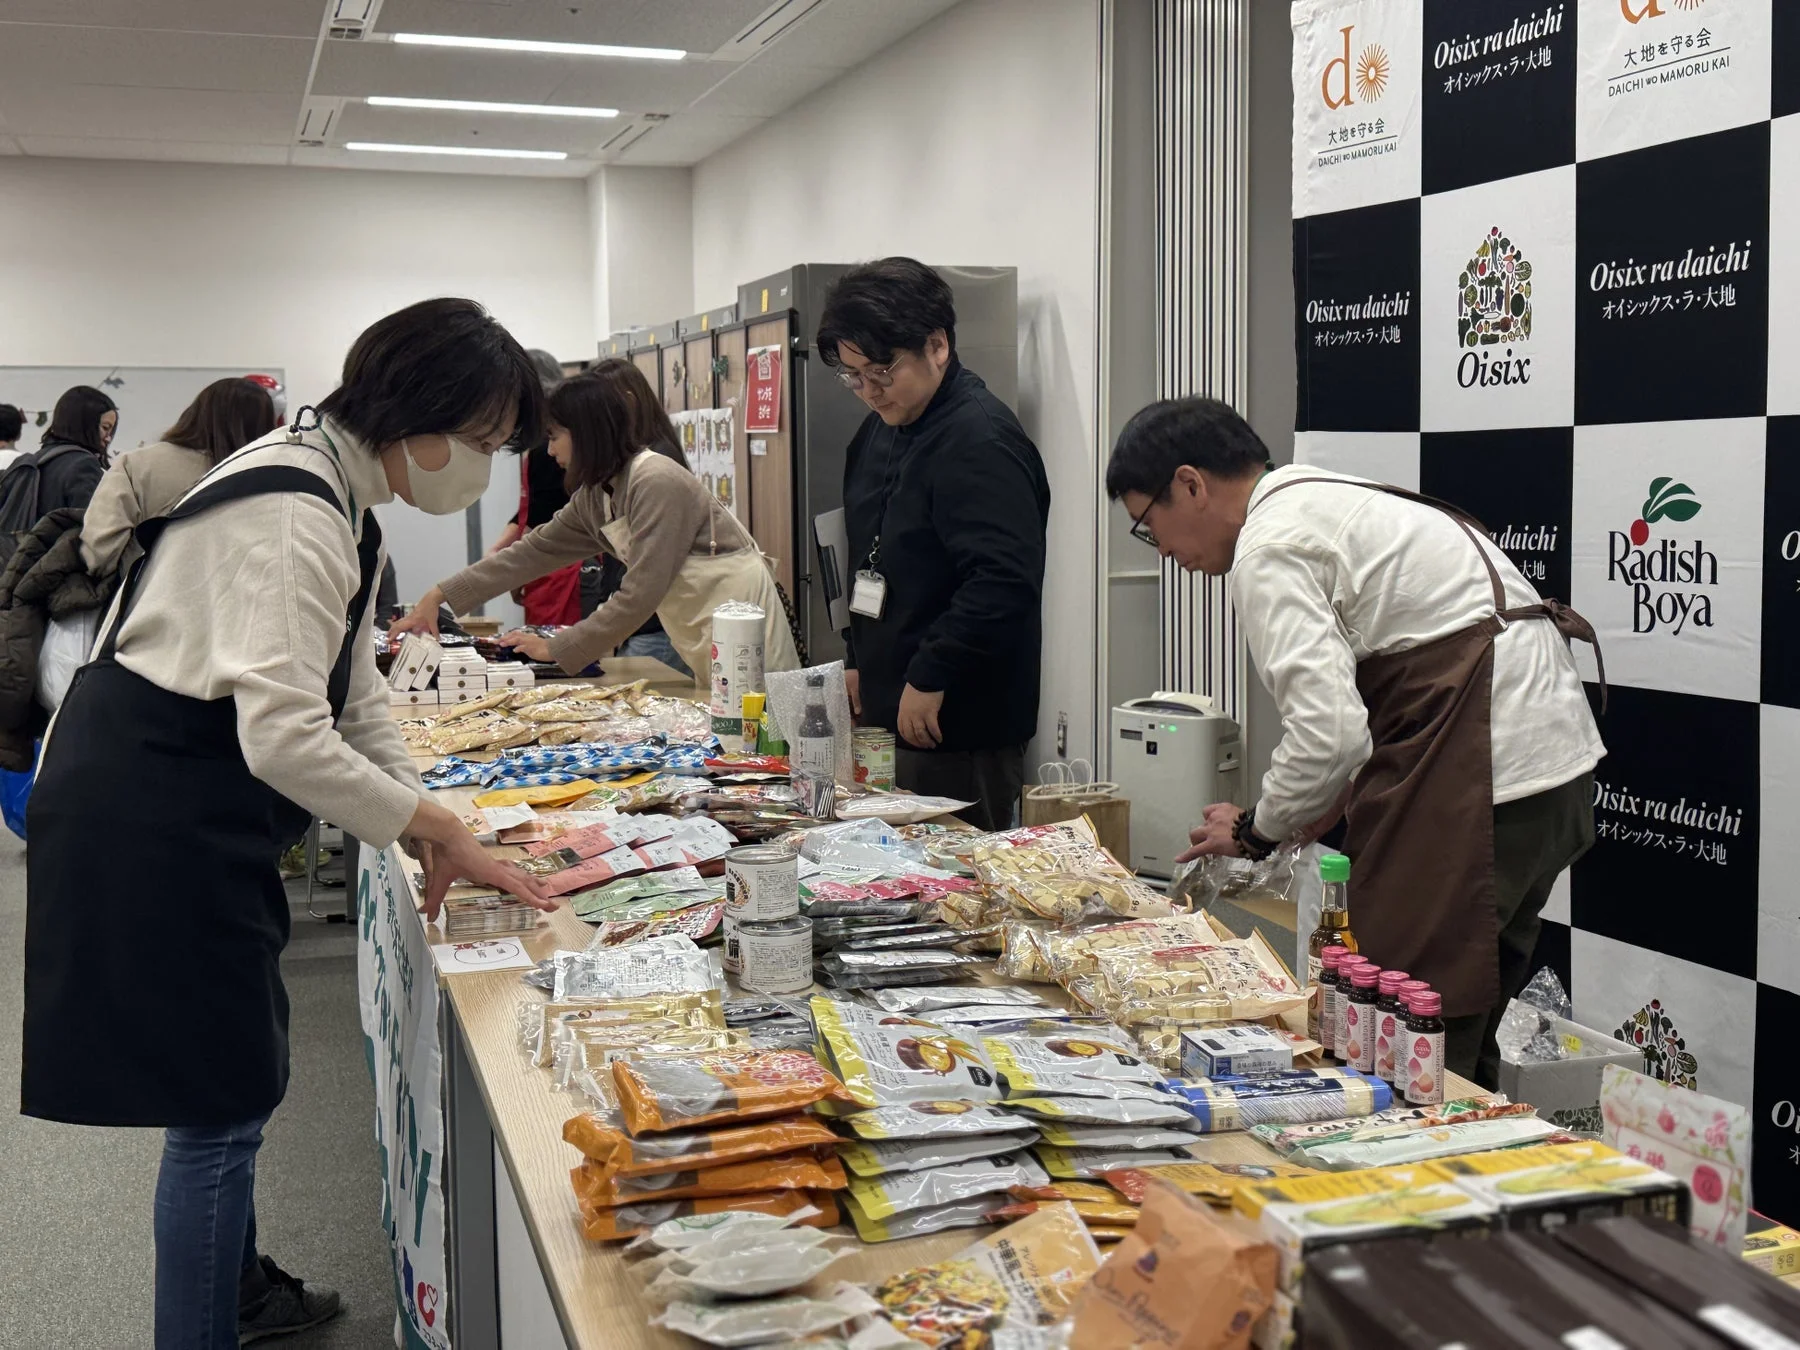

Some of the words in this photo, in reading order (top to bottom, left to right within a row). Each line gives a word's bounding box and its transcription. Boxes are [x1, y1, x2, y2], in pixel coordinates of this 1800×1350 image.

[1435, 34, 1480, 68] Oisix
[1483, 32, 1502, 54] ra
[1506, 4, 1563, 47] daichi
[1624, 28, 1711, 68] 大地を守る会
[1444, 46, 1551, 93] オイシックス・ラ・大地
[1608, 78, 1644, 97] DAICHI
[1660, 61, 1709, 83] MAMORU
[1712, 56, 1730, 71] KAI
[1329, 118, 1384, 145] 大地を守る会
[1318, 154, 1342, 167] DAICHI
[1351, 146, 1383, 160] MAMORU
[1385, 142, 1397, 153] KAI
[1591, 258, 1646, 291] Oisix
[1651, 261, 1674, 283] ra
[1677, 240, 1751, 279] daichi
[1306, 299, 1343, 323] Oisix
[1345, 304, 1361, 321] ra
[1362, 291, 1410, 318] daichi
[1603, 284, 1736, 319] オイシックス・ラ・大地
[1458, 349, 1531, 388] Oisix
[1500, 525, 1558, 551] daichi
[1608, 531, 1718, 586] Radish
[1633, 583, 1714, 636] Boya
[1644, 799, 1667, 820] ra
[1671, 798, 1742, 836] daichi
[1597, 819, 1727, 865] オイシックス・ラ・大地
